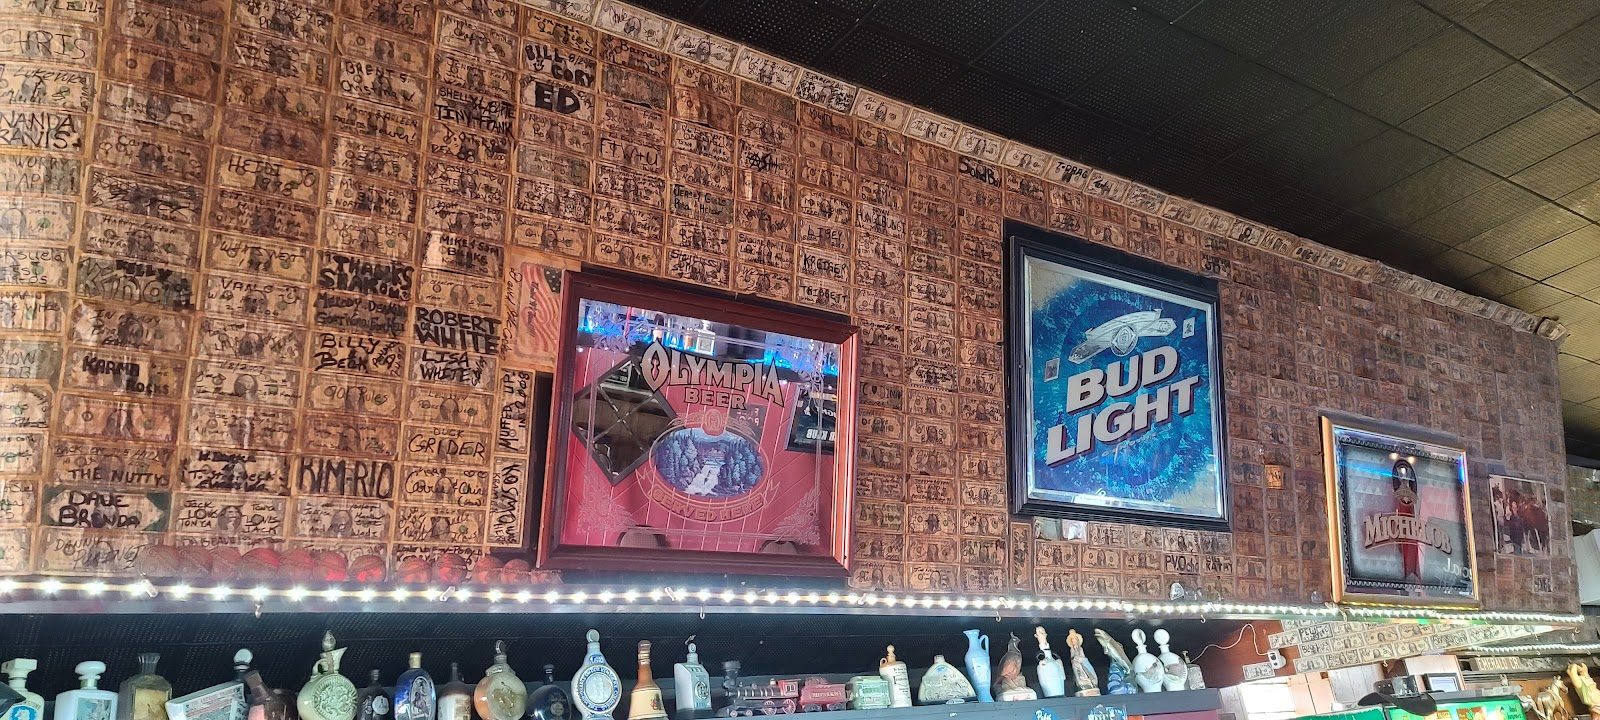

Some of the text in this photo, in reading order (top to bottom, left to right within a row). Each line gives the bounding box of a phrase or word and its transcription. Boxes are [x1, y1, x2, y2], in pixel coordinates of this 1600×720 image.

[535, 82, 580, 114] ED
[415, 307, 502, 335] ROBERT
[413, 324, 501, 355] WHITE
[422, 350, 469, 367] LISA
[640, 339, 784, 407] OLYMPIA
[1066, 345, 1180, 416] BUD
[684, 387, 747, 410] BEER
[499, 405, 519, 450] MUFFED
[1046, 375, 1200, 467] LIGHT
[409, 434, 485, 460] GRIDER
[68, 467, 102, 481] THE
[720, 497, 763, 521] HERE
[1364, 511, 1453, 555] MICHELOB
[1477, 656, 1508, 671] EMERALD
